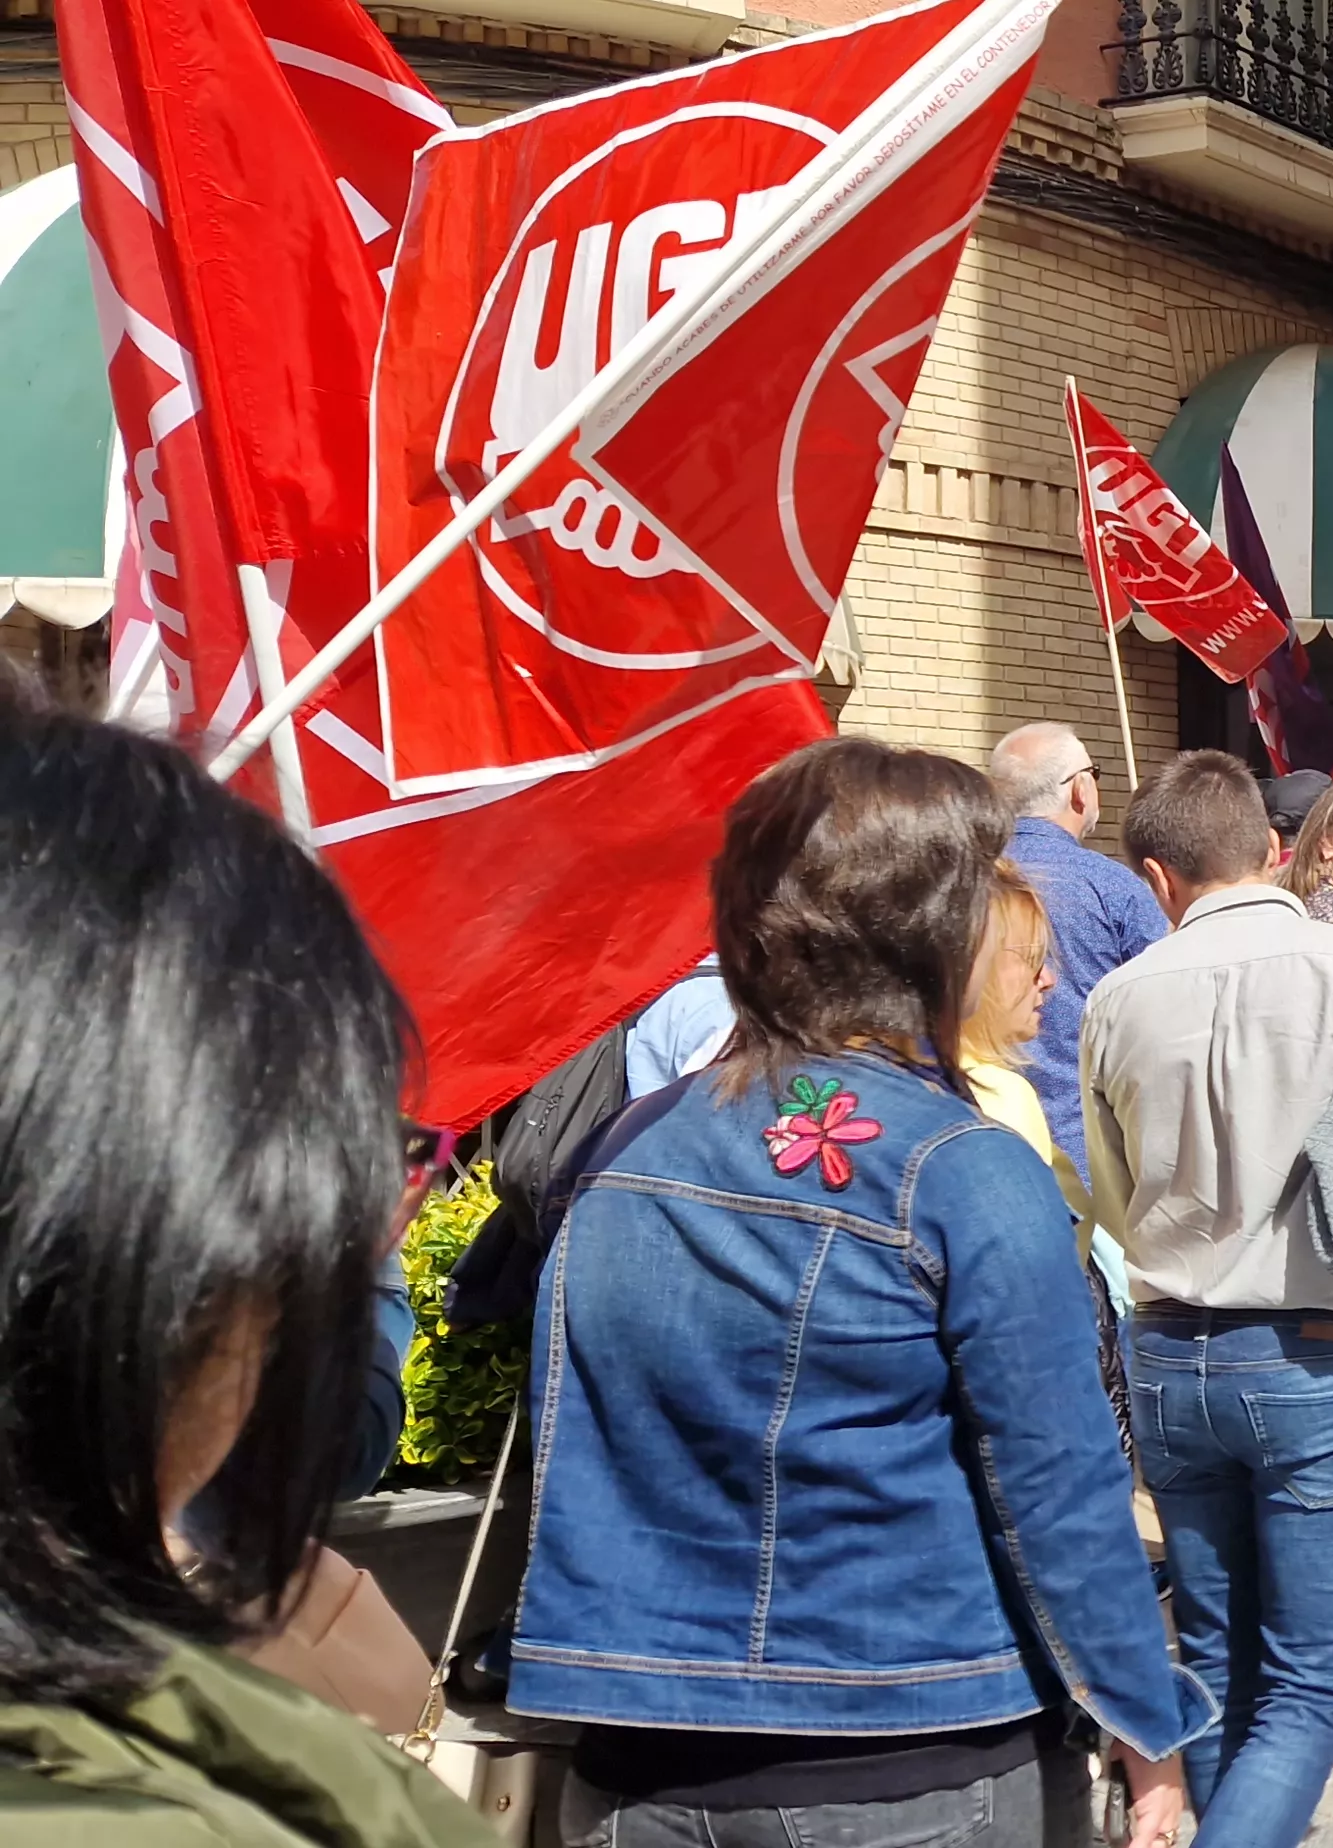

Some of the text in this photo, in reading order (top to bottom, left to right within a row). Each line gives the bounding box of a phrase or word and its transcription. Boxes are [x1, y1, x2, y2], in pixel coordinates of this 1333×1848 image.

[675, 313, 719, 355] ACABES
[720, 296, 737, 312] DE
[810, 203, 835, 226] POR
[873, 94, 947, 166] DEPOSÍTAME
[944, 78, 965, 99] EN
[960, 67, 979, 83] EL
